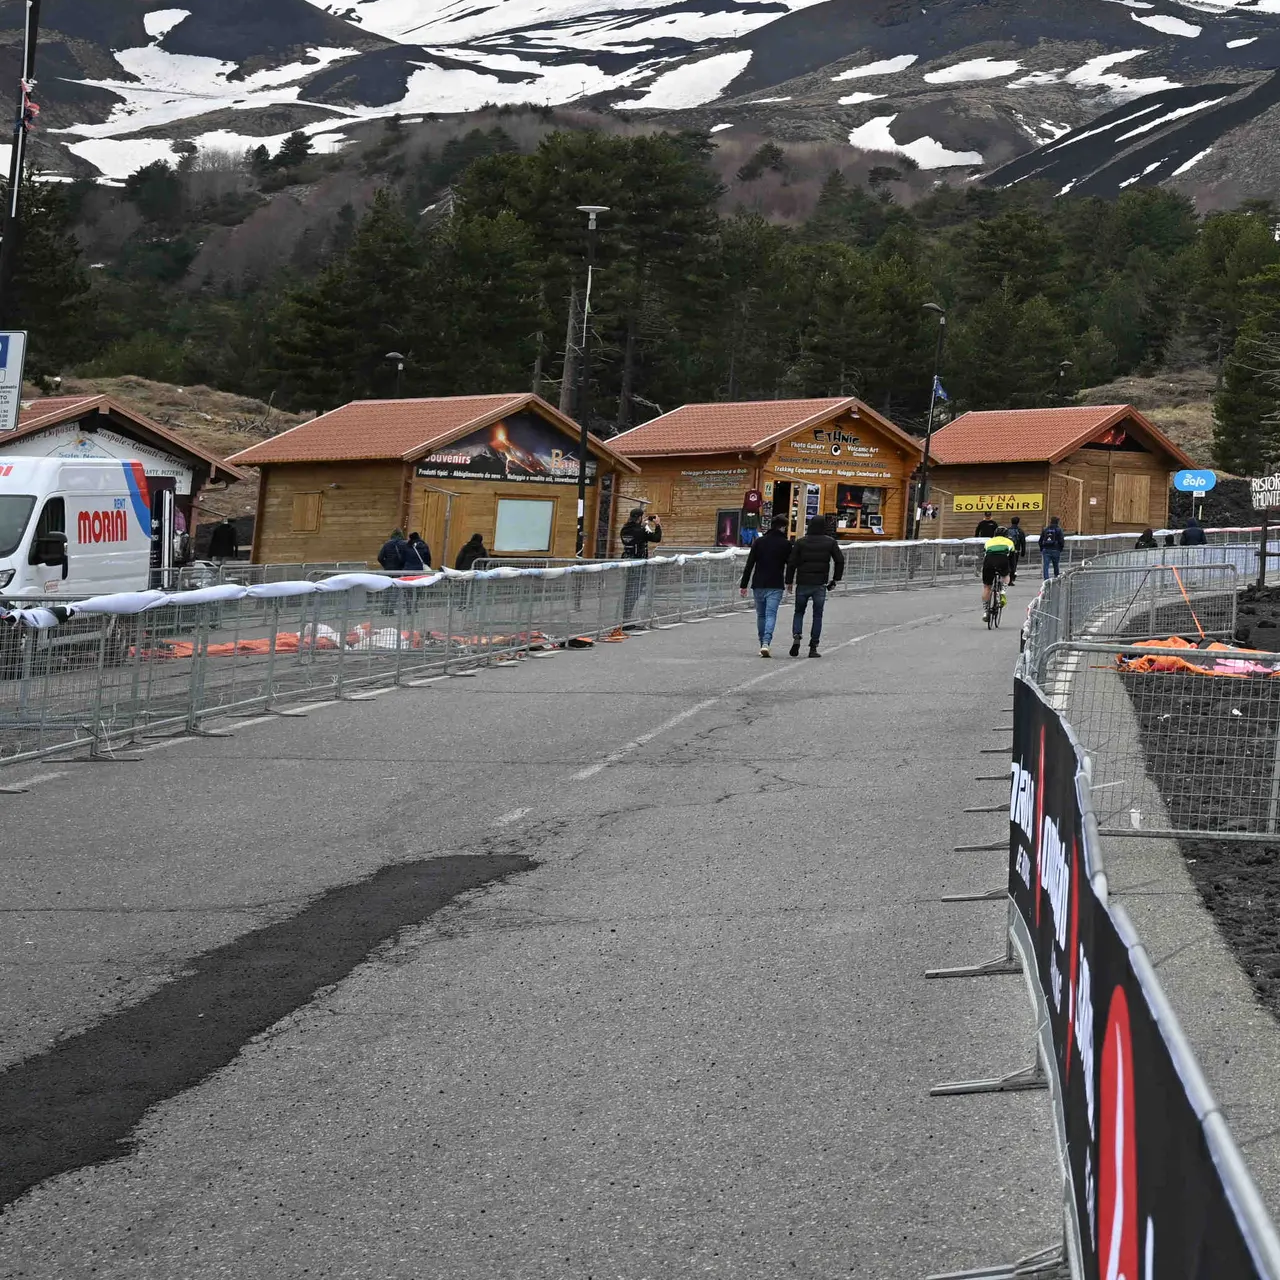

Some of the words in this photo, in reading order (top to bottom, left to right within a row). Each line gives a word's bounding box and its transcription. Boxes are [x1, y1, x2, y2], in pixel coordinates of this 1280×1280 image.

[1183, 476, 1206, 487] eolo
[978, 495, 1016, 503] ETNA
[1257, 491, 1280, 507] MONTE
[955, 501, 1040, 511] SOUVENIRS
[78, 510, 128, 544] MORINI
